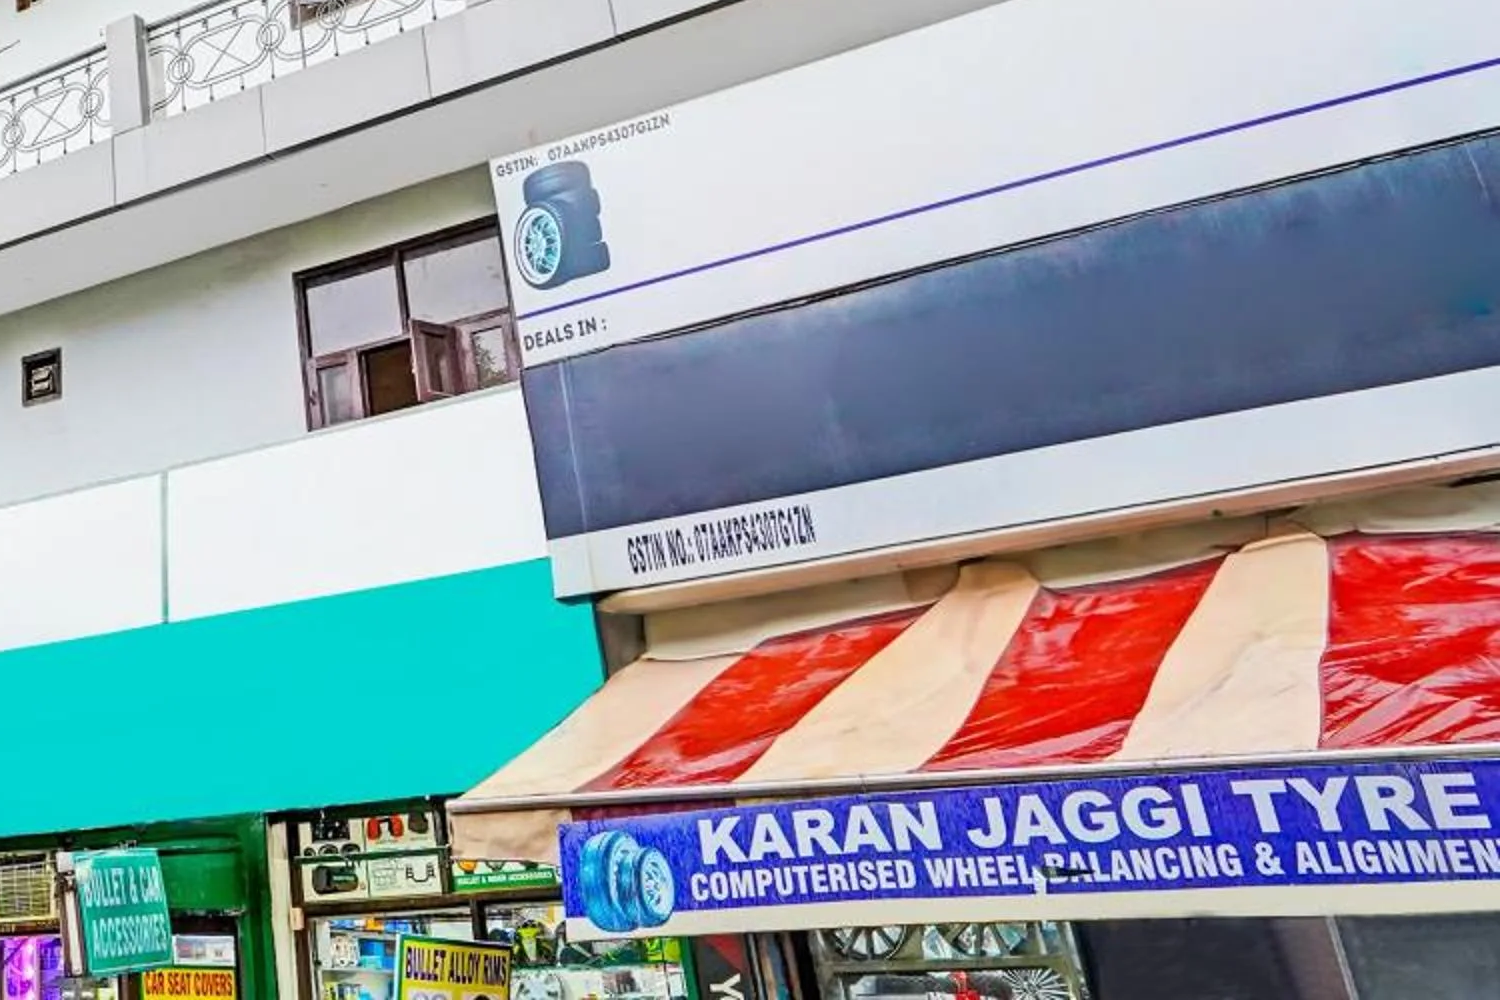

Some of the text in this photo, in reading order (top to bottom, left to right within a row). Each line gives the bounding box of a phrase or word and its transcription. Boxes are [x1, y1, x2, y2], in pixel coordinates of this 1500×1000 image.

[523, 324, 574, 351] DEALS
[578, 319, 598, 337] IN
[627, 531, 667, 574] GSTIN
[698, 772, 1491, 866] KARAN JAGGI TYRE
[690, 837, 1500, 901] COMPUTERISED WHEEL BALANCING & ALIGNMEN
[93, 914, 168, 957] ACCESSORIES
[144, 971, 233, 997] CAR SEAT COVERS
[405, 945, 446, 982] BULLET
[448, 951, 480, 985] ALLOY
